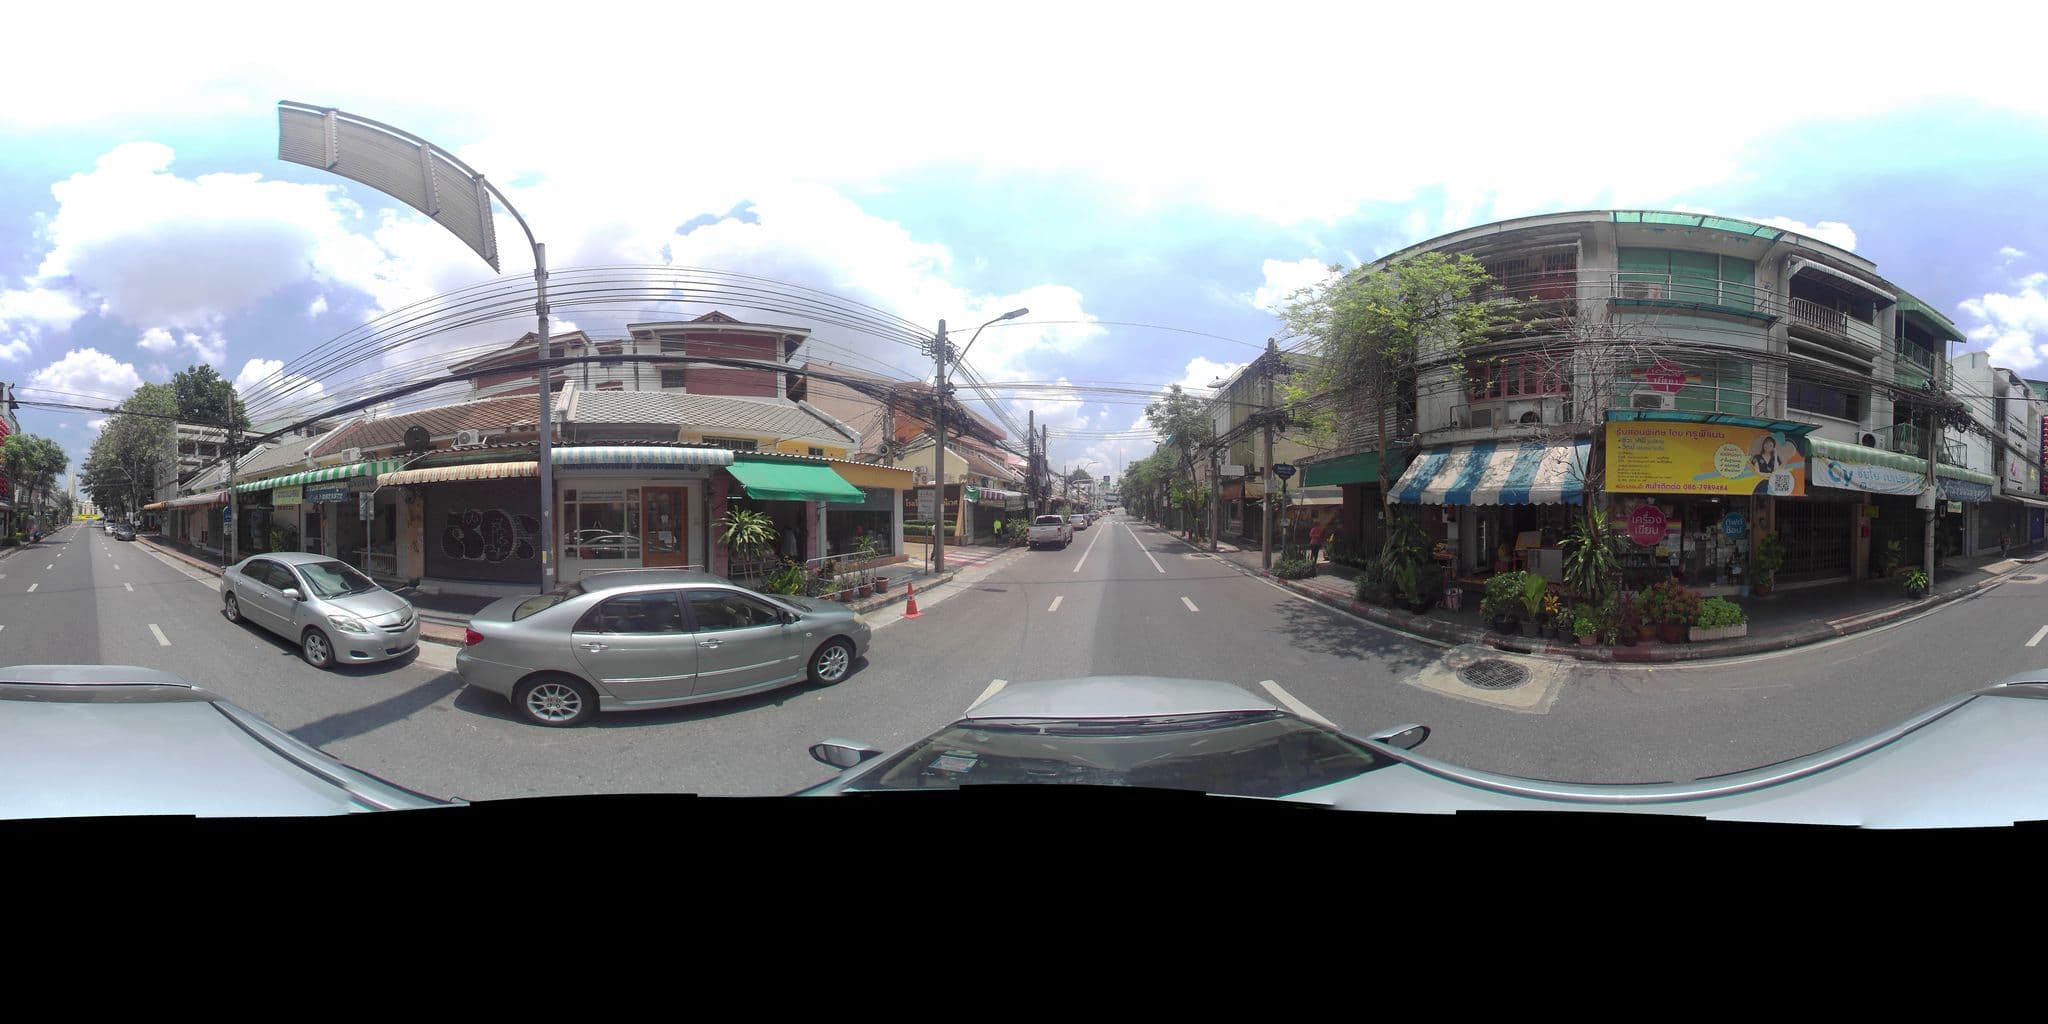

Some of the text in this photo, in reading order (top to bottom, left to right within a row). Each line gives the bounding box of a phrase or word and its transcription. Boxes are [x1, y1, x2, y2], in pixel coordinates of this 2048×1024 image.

[1632, 510, 1662, 525] เครื่อง
[1634, 524, 1659, 535] เขียน
